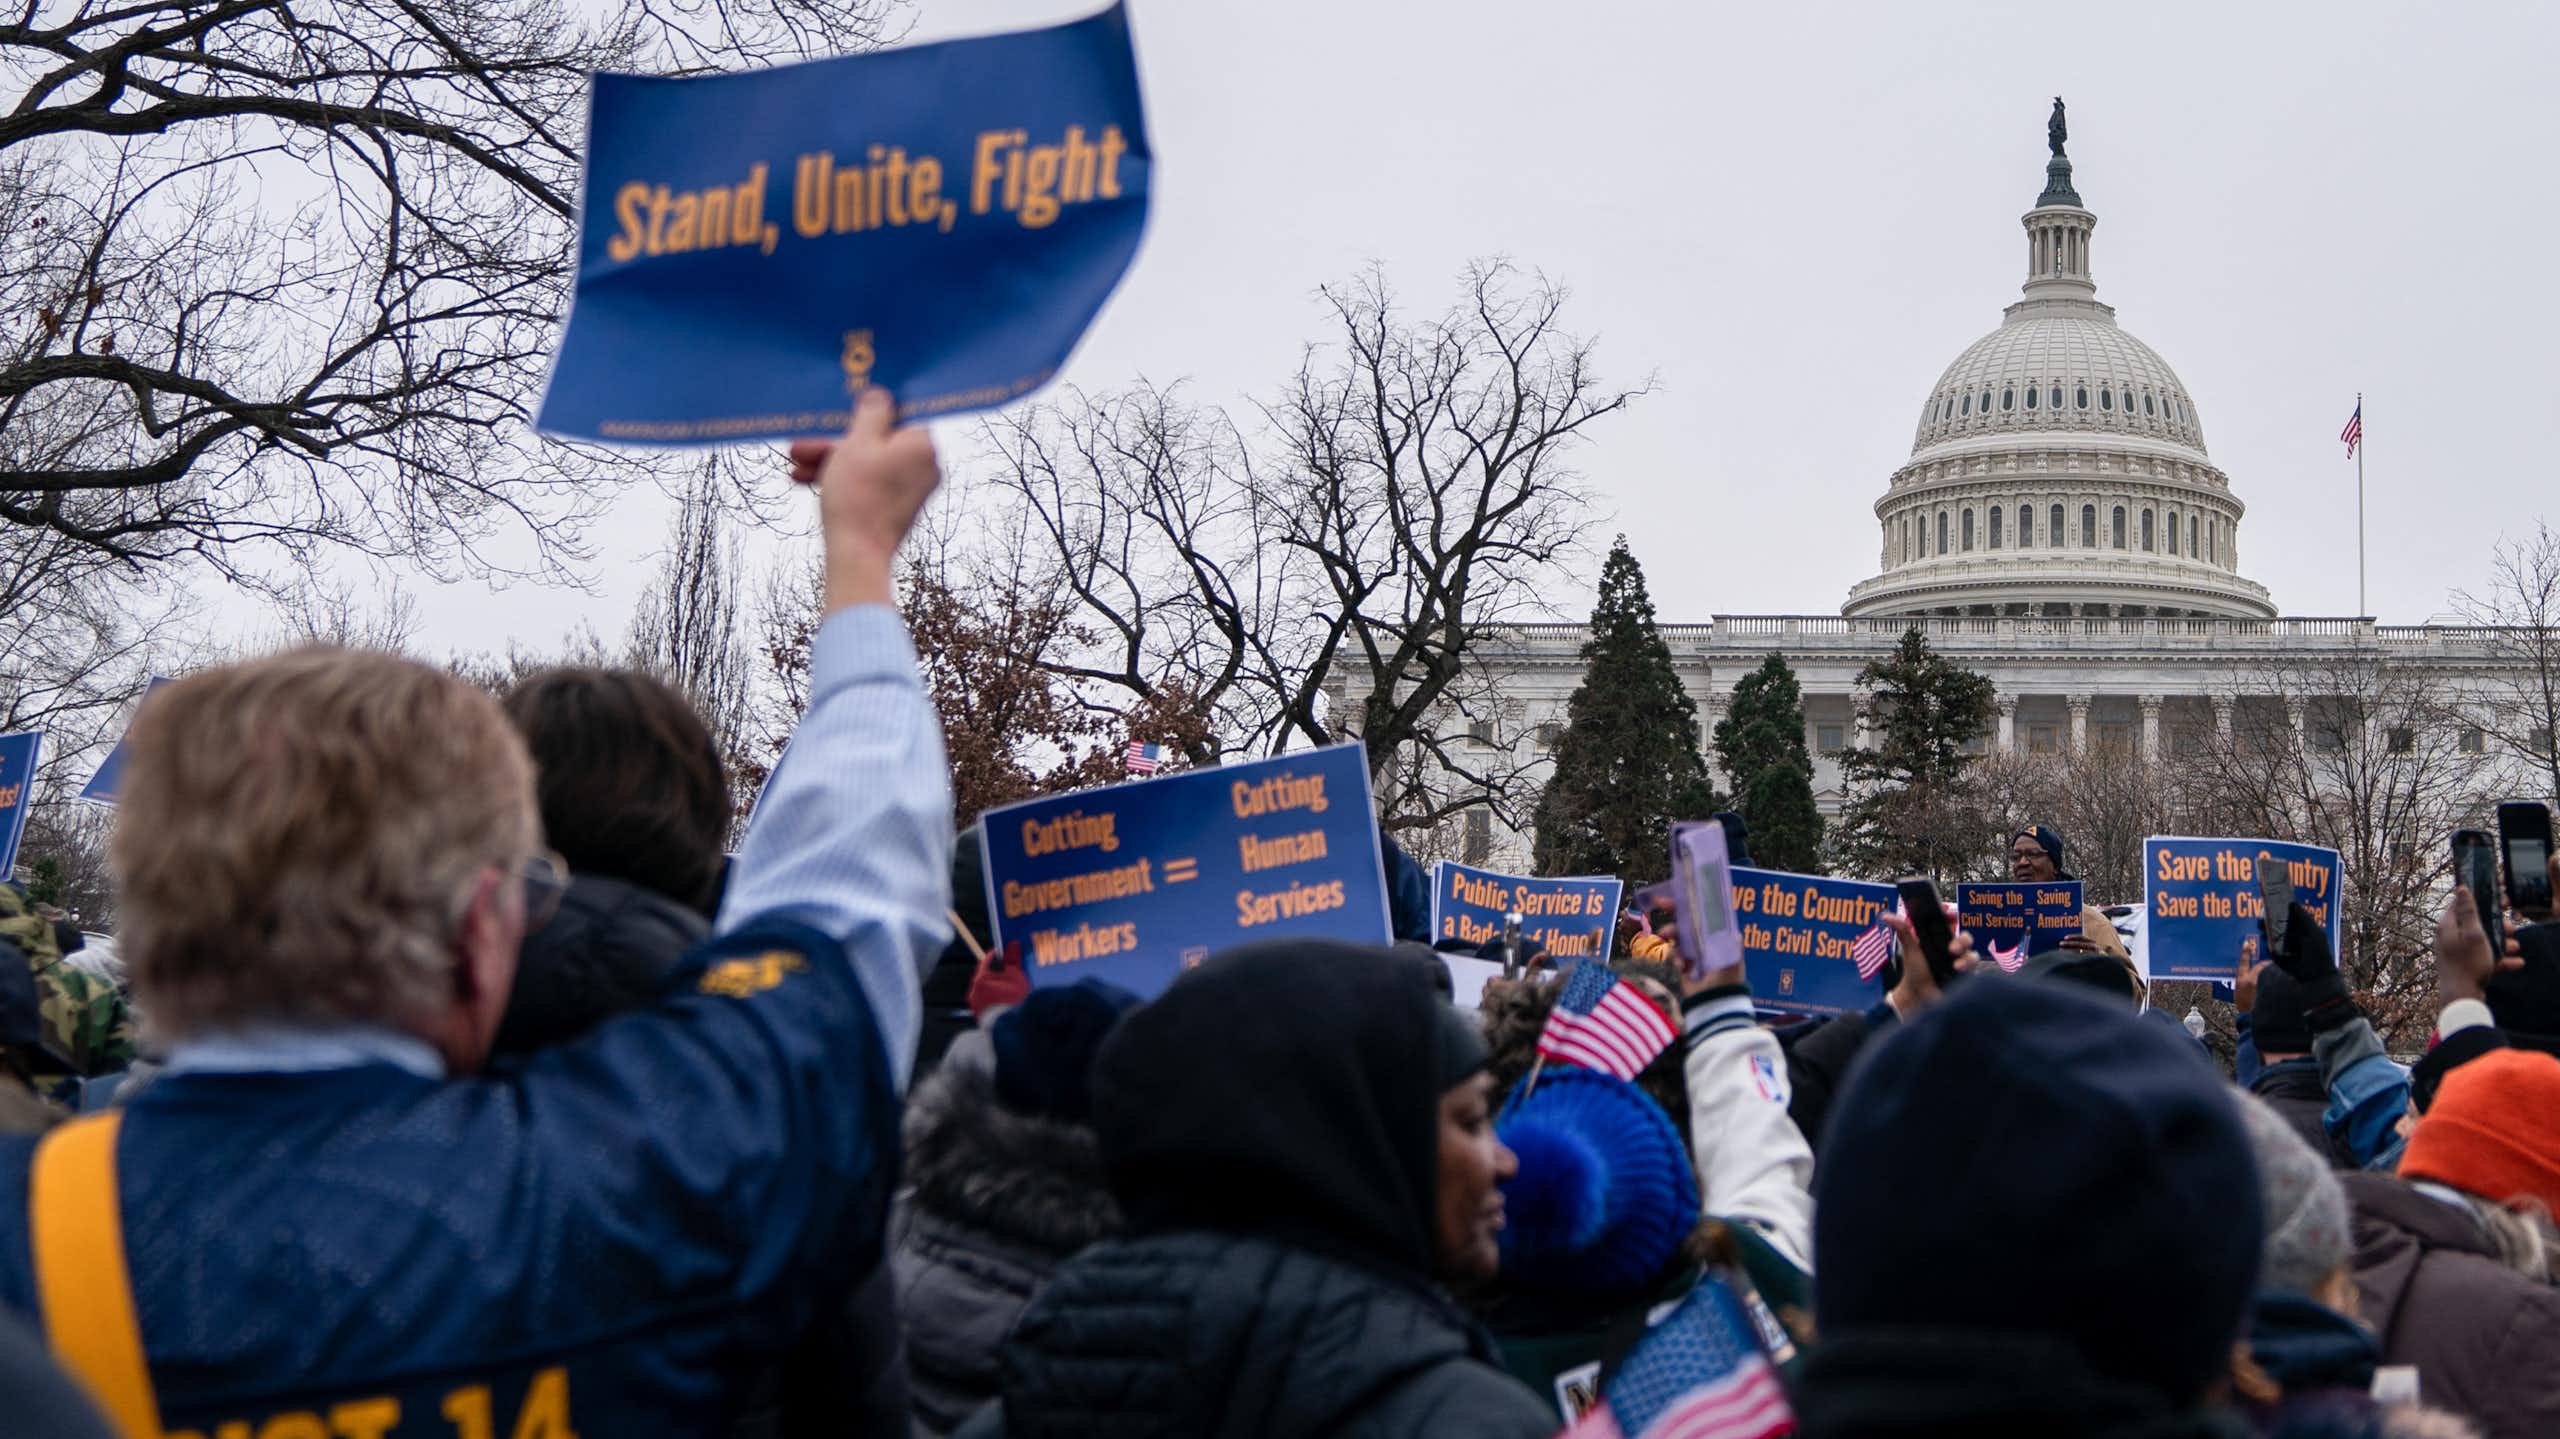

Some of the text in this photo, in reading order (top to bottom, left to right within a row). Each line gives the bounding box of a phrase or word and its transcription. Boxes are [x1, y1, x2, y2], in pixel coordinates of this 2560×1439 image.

[608, 124, 1127, 262] Stand, Unite, Fight
[1232, 772, 1329, 818] Cutting
[1022, 809, 1120, 858] Cutting
[1239, 830, 1327, 872] Human
[2157, 848, 2210, 882] Save
[2215, 849, 2253, 882] the
[1002, 856, 1198, 918] Government =
[1236, 880, 1345, 927] Services
[1452, 871, 1605, 917] Public Service is
[1761, 883, 1798, 918] the
[1968, 889, 2024, 909] Saving the
[2037, 888, 2072, 908] Saving
[2156, 890, 2264, 918] Save the Civ
[1443, 915, 1456, 938] a
[1960, 912, 2024, 929] Civil Service
[2037, 910, 2083, 929] America!
[1031, 921, 1138, 967] Workers
[1743, 923, 1772, 951] the
[1775, 926, 1813, 955] Civil
